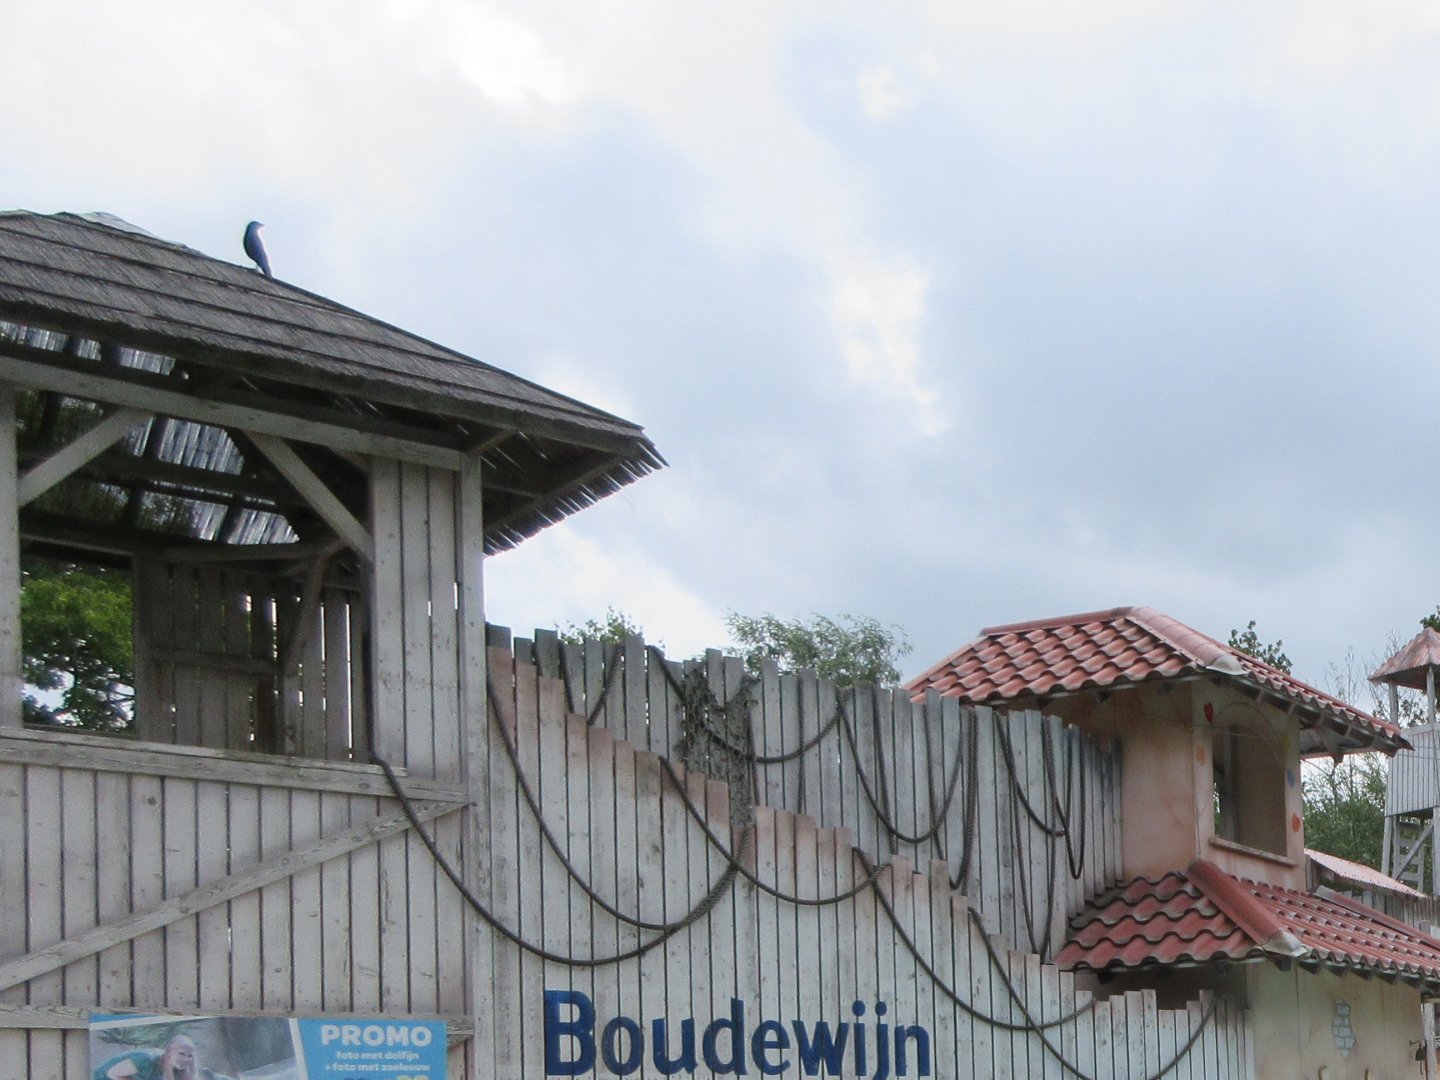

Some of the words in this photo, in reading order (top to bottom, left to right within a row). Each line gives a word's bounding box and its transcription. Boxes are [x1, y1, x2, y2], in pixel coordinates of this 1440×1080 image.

[321, 1024, 433, 1047] PROMO
[336, 1050, 359, 1060] foto
[361, 1051, 383, 1060] met
[384, 1051, 420, 1062] dolfijn
[333, 1063, 356, 1071] foto
